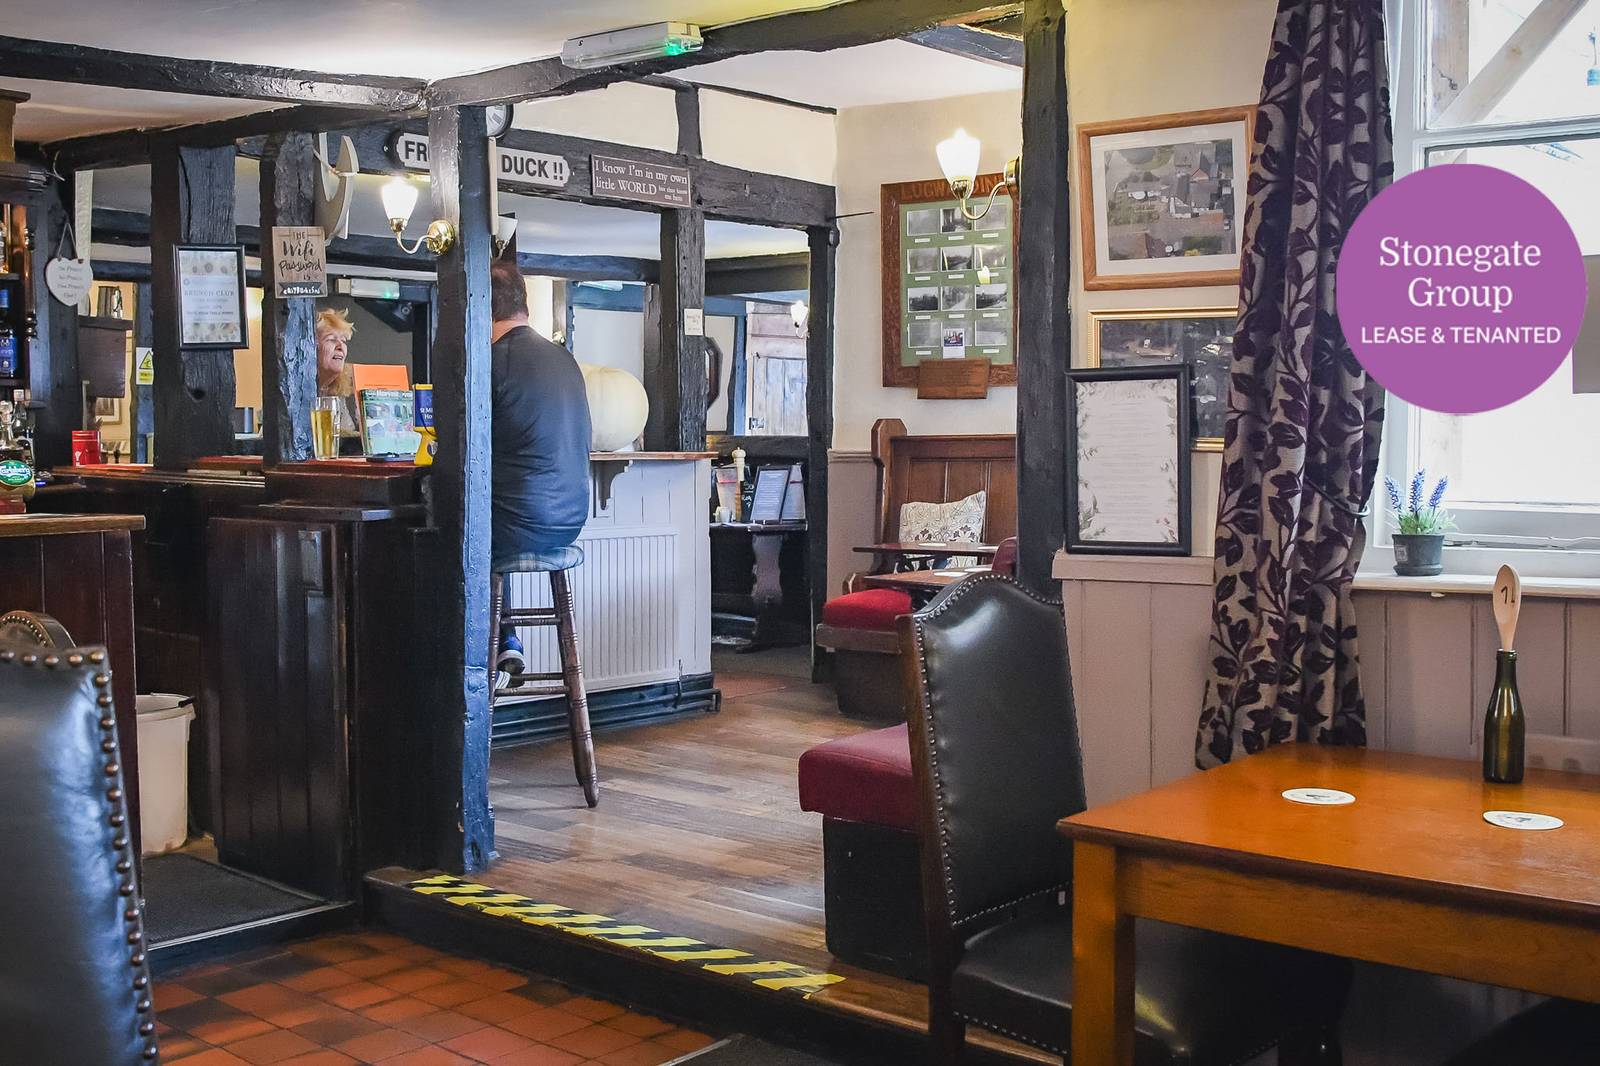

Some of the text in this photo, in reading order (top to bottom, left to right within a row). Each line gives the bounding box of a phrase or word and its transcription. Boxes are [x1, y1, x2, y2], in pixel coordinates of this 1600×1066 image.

[502, 154, 549, 179] DUCK
[553, 161, 563, 181] !!
[595, 160, 687, 184] I know I'm in my own
[596, 176, 615, 190] little
[618, 179, 657, 195] WORLD
[293, 231, 305, 240] THE
